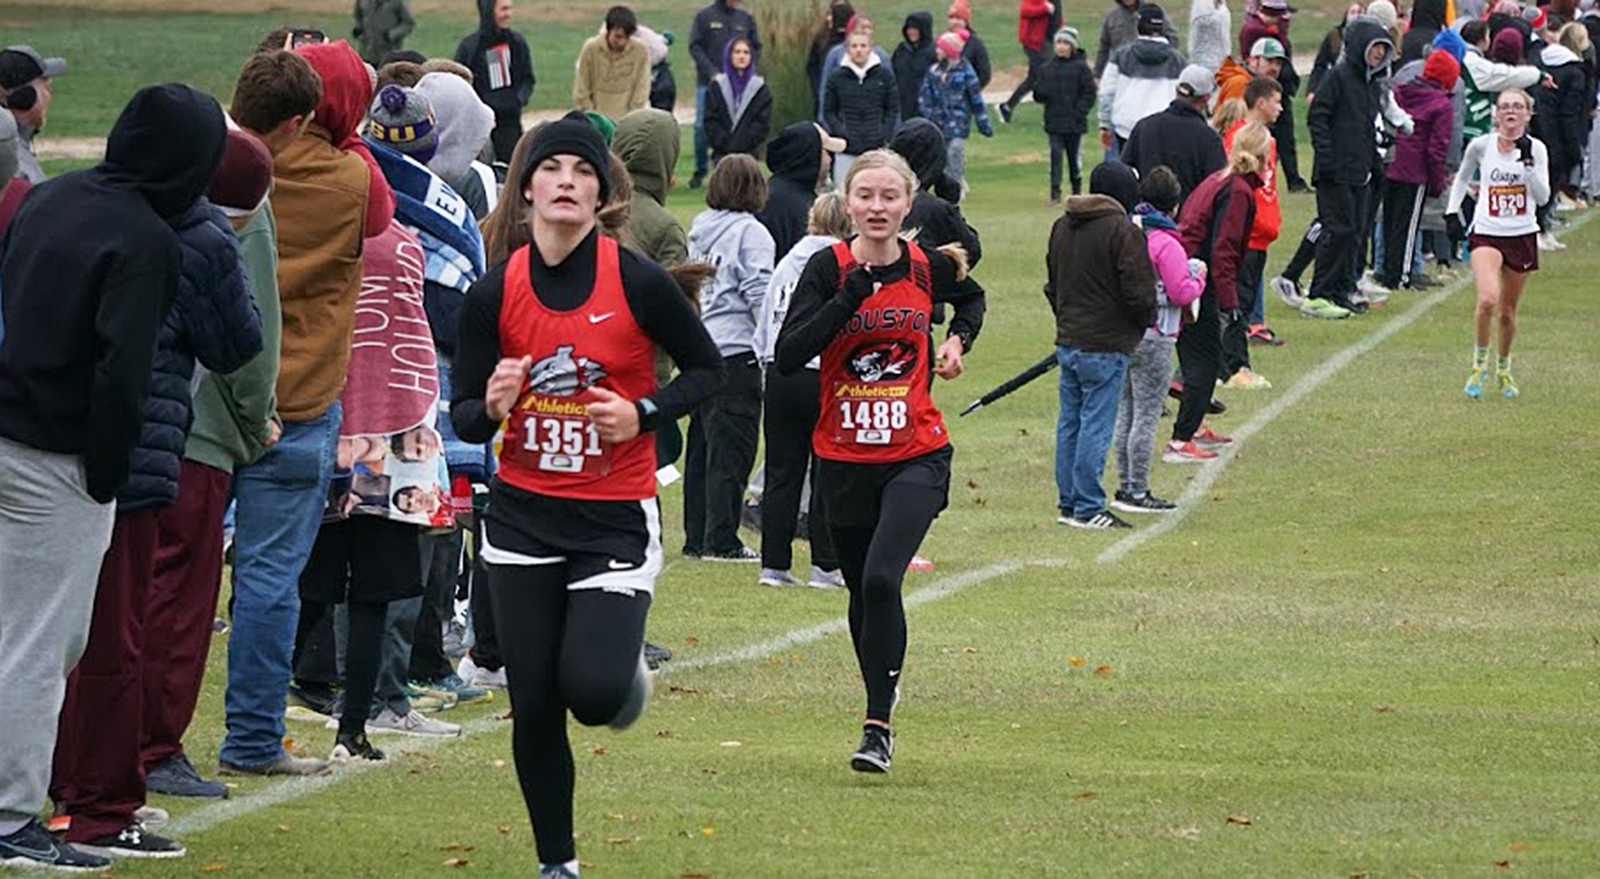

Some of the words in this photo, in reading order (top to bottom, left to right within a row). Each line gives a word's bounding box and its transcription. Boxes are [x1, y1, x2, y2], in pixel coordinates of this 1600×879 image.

[1491, 194, 1525, 210] 1620
[843, 307, 926, 334] OUSTO
[840, 401, 907, 430] 1488
[524, 416, 603, 456] 1351
